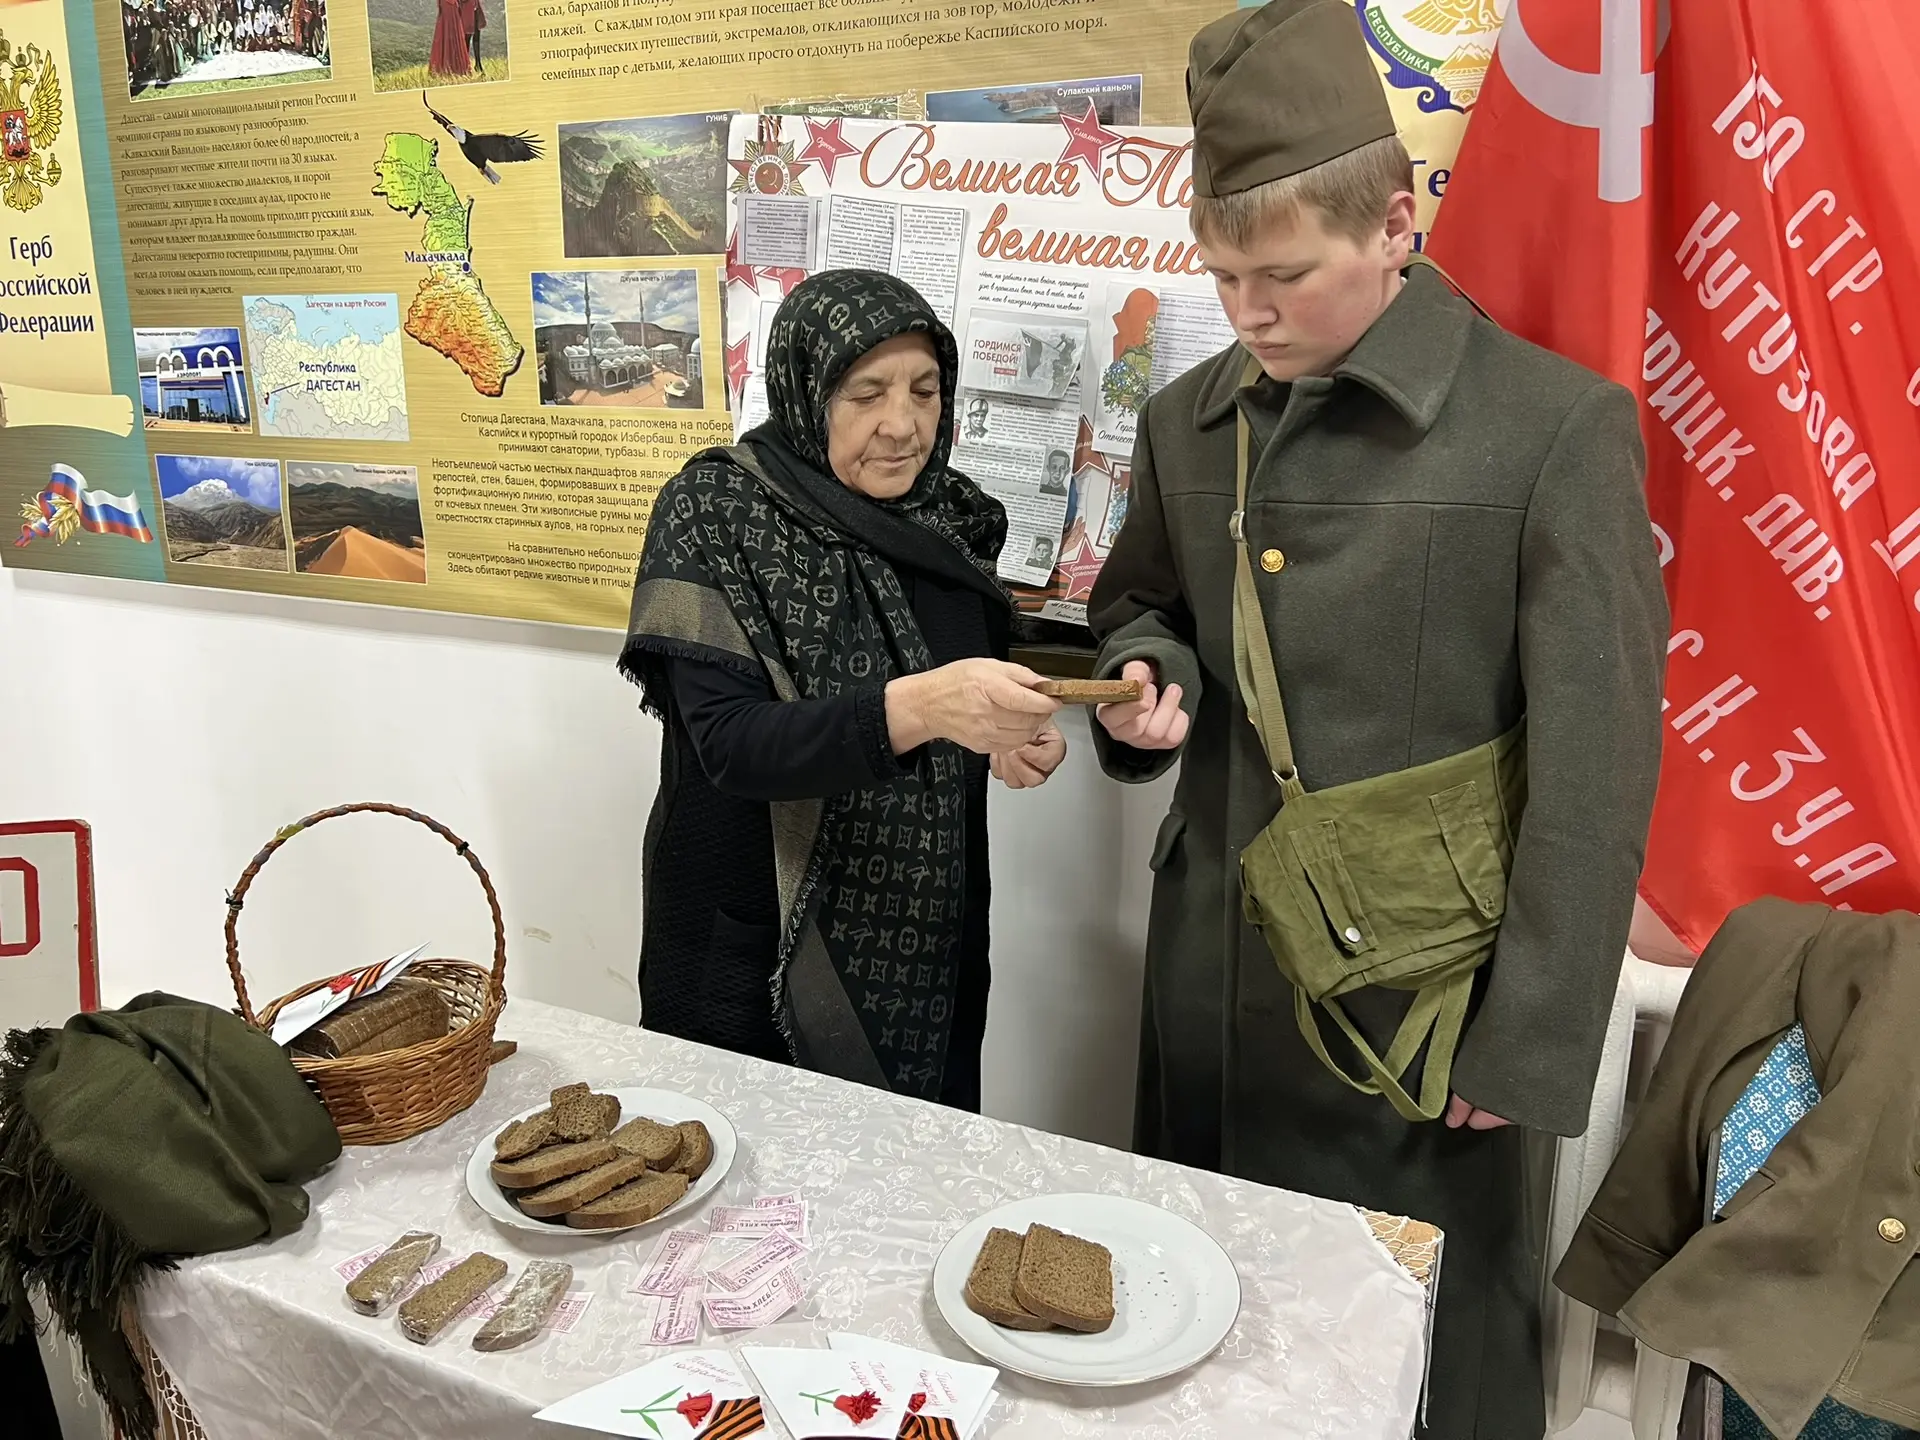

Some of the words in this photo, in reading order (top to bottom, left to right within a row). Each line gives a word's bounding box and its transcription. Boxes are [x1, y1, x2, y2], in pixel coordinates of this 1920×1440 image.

[538, 6, 564, 16] скал,
[568, 0, 619, 16] барханов
[539, 24, 585, 38] пляжей.
[606, 17, 652, 30] каждым
[656, 13, 690, 25] годом
[695, 10, 715, 20] эти
[719, 6, 746, 22] края
[752, 1, 814, 14] посещает
[540, 42, 638, 60] этнографических
[640, 33, 720, 52] путешествий,
[724, 25, 808, 42] экстремалов,
[812, 12, 919, 32] откликающихся
[924, 10, 939, 20] на
[944, 6, 966, 17] зов
[971, 4, 997, 18] гор,
[1368, 9, 1431, 72] РЕСПУБЛИКА
[541, 68, 596, 80] семейных
[599, 66, 619, 78] пар
[631, 60, 674, 74] детьми,
[678, 53, 744, 67] желающих
[748, 49, 793, 63] просто
[797, 43, 864, 57] отдохнуть
[868, 41, 882, 51] на
[886, 33, 960, 48] побережье
[966, 22, 1059, 40] Каспийского
[1064, 17, 1106, 31] моря.
[1057, 84, 1100, 97] Сулакский
[1102, 83, 1132, 92] каньон
[282, 97, 313, 111] регион
[315, 94, 347, 104] России
[242, 116, 308, 133] разнообразию.
[705, 113, 728, 123] ГУНИБ
[212, 142, 251, 151] населяют
[253, 139, 278, 148] более
[280, 135, 290, 148] 60
[291, 131, 351, 148] народностей,
[215, 160, 249, 170] жители
[251, 157, 277, 168] почти
[279, 156, 289, 167] на
[291, 153, 301, 164] 30
[303, 154, 337, 163] языках.
[860, 123, 1080, 197] Великая
[1102, 136, 1193, 208] По
[245, 176, 291, 186] диалектов,
[302, 169, 330, 185] порой
[219, 194, 257, 205] соседних
[258, 194, 286, 207] аулах,
[287, 192, 318, 205] просто
[320, 192, 331, 201] не
[216, 213, 228, 223] На
[229, 214, 265, 222] помощь
[267, 209, 309, 224] приходит
[311, 207, 348, 222] русский
[350, 208, 374, 216] язык,
[256, 229, 315, 240] большинство
[317, 228, 356, 239] граждан.
[977, 202, 1149, 270] великая
[1153, 240, 1207, 275] ис
[9, 235, 53, 267] Герб
[226, 249, 291, 261] гостеприимны,
[293, 247, 336, 260] радушны.
[338, 245, 358, 256] Они
[404, 250, 466, 263] Махачкала
[218, 265, 255, 276] помощь,
[257, 267, 277, 275] если
[279, 263, 344, 278] предполагают,
[1785, 188, 1883, 336] СТР.
[0, 271, 91, 297] оссийской
[306, 300, 334, 308] Дагестан
[344, 301, 362, 310] карте
[363, 300, 386, 308] России
[974, 339, 1021, 352] ГОРДИМСЯ
[972, 350, 1019, 364] ПОБЕДОЙ!
[1674, 200, 1877, 512] КУТУЗОВА
[298, 361, 356, 375] Республика
[306, 379, 360, 392] ДАГЕСТАН
[1641, 307, 1756, 502] РИЦК.
[460, 412, 498, 424] Столица
[500, 413, 548, 425] Дагестана,
[550, 415, 606, 427] Махачкала,
[610, 419, 677, 429] расположена
[680, 421, 692, 429] на
[478, 427, 519, 437] Каспийск
[529, 430, 577, 441] курортный
[580, 432, 617, 442] городок
[621, 432, 676, 444] Избербаш.
[1098, 430, 1134, 444] Отечест
[498, 443, 549, 453] принимают
[551, 445, 602, 456] санатории,
[605, 446, 648, 458] турбазы.
[432, 458, 497, 470] Неотъемлемой
[499, 463, 531, 472] частью
[534, 464, 573, 474] местных
[575, 467, 637, 478] ландшафтов
[432, 473, 478, 483] крепостей,
[481, 476, 502, 484] стен,
[505, 474, 537, 487] башен,
[539, 477, 618, 490] формировавших
[433, 485, 520, 500] фортификационную
[522, 492, 554, 502] линию,
[557, 494, 594, 504] которая
[596, 496, 648, 507] защищала
[434, 500, 444, 508] от
[445, 500, 481, 509] кочевых
[483, 503, 518, 512] племен.
[521, 503, 538, 513] Эти
[540, 507, 597, 517] живописные
[600, 510, 631, 521] руины
[436, 513, 493, 524] окрестностях
[495, 517, 542, 527] старинных
[544, 521, 573, 531] аулов,
[590, 524, 624, 534] горных
[507, 541, 520, 551] На
[522, 545, 585, 556] сравнительно
[1742, 491, 1844, 622] ДИВ.
[447, 550, 525, 564] сконцентрировано
[527, 558, 577, 573] множество
[578, 560, 631, 574] природных
[447, 562, 473, 573] Здесь
[475, 565, 511, 576] обитают
[513, 570, 542, 579] редкие
[545, 574, 589, 584] животные
[752, 1292, 772, 1309] ХЛЕБ
[771, 1278, 780, 1288] С
